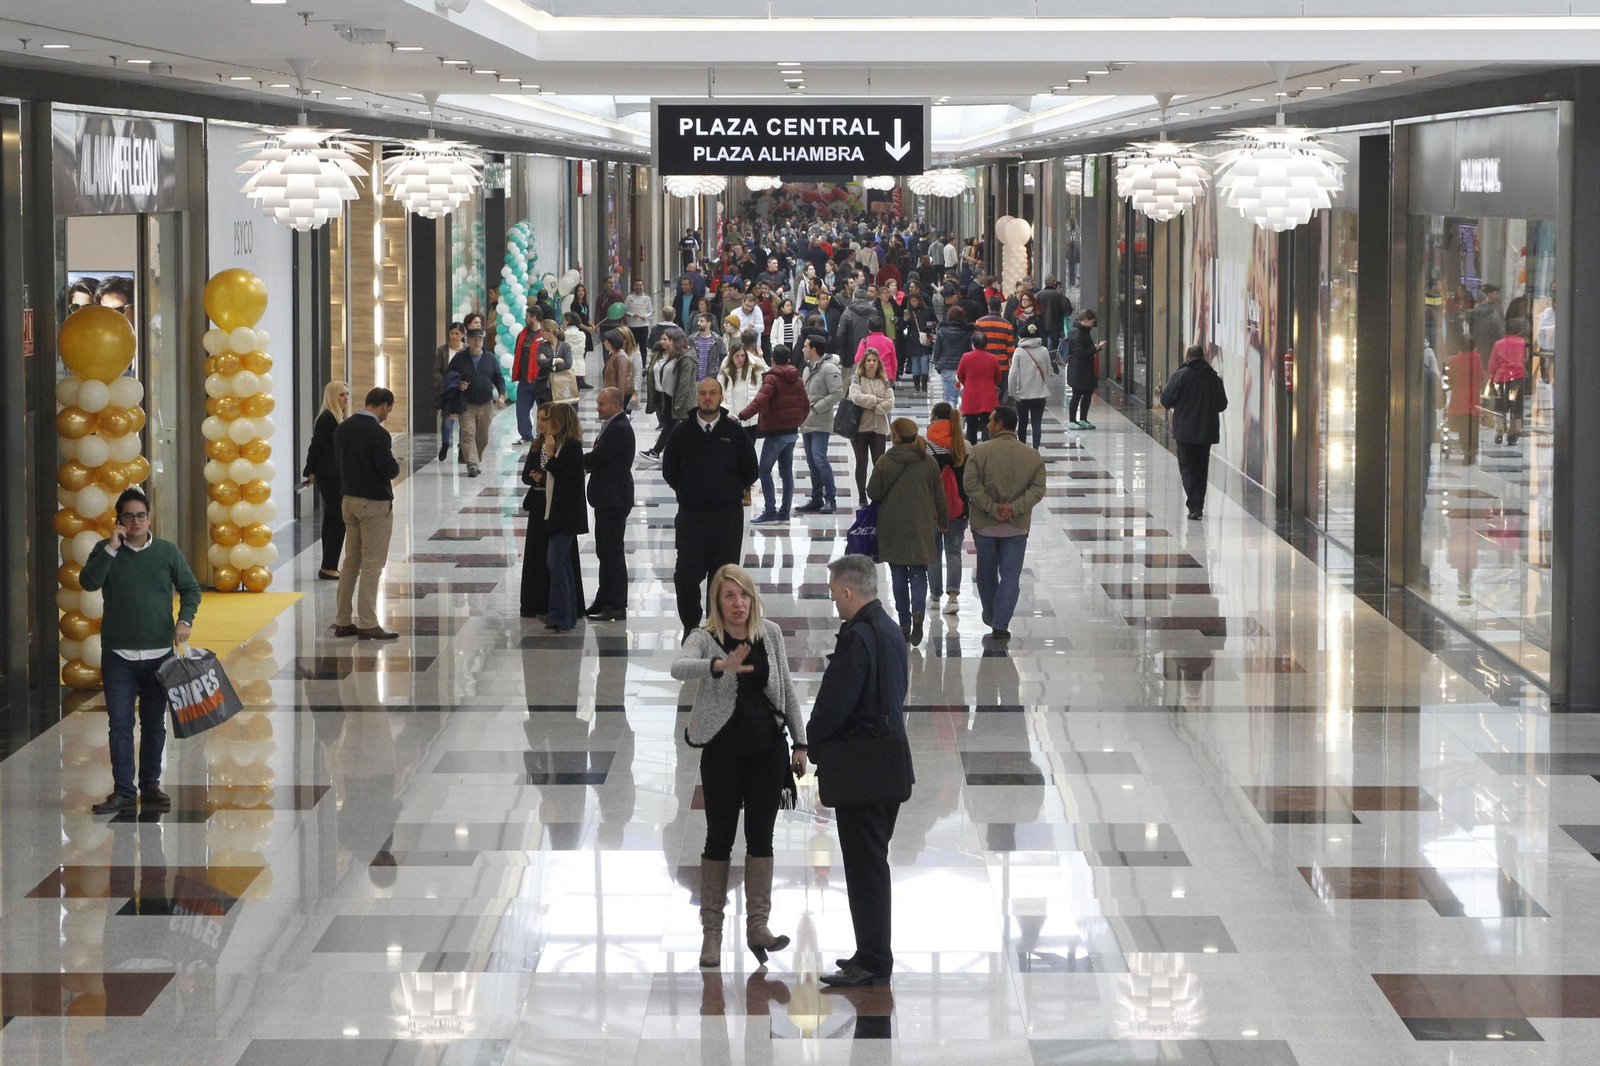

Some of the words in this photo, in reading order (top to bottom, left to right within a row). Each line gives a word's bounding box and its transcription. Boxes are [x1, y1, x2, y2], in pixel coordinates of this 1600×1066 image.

[679, 118, 758, 136] PLAZA
[766, 118, 880, 136] CENTRAL
[693, 146, 754, 162] PLAZA
[757, 146, 865, 162] ALHAMBRA
